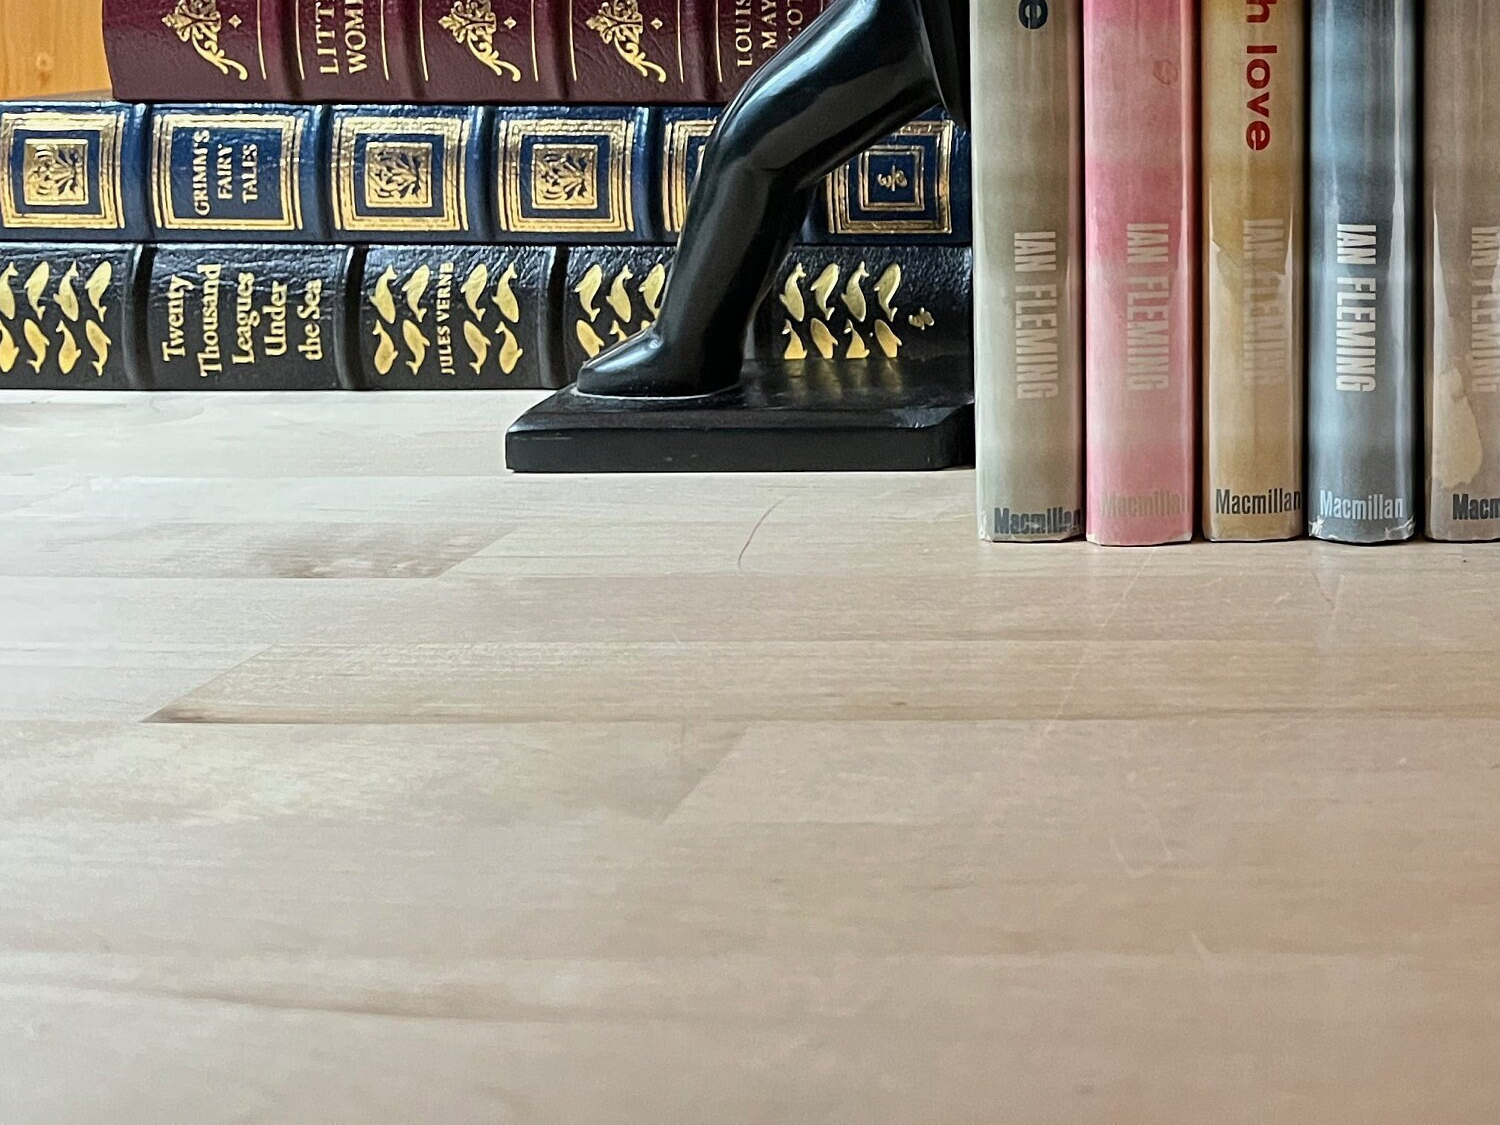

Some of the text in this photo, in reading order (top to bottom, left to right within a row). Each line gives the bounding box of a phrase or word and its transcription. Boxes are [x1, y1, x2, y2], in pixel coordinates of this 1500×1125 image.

[1245, 45, 1278, 152] love
[193, 130, 210, 216] GRIMM'S
[217, 144, 233, 200] FAIRY
[242, 143, 258, 204] TALES
[1243, 219, 1284, 259] IAN
[162, 274, 194, 362] Twenty
[197, 263, 222, 377] Thousand
[232, 272, 260, 365] Leagues
[262, 280, 288, 357] Under
[297, 278, 323, 361] the Sea
[436, 261, 456, 375] JULES VERNE
[1014, 232, 1058, 399] IAN FLEMING
[1127, 223, 1169, 391] IAN FLEMING
[1336, 224, 1377, 392] IAN FLEMING
[1216, 488, 1300, 515] Macmillan
[1320, 490, 1403, 520] Macmillan
